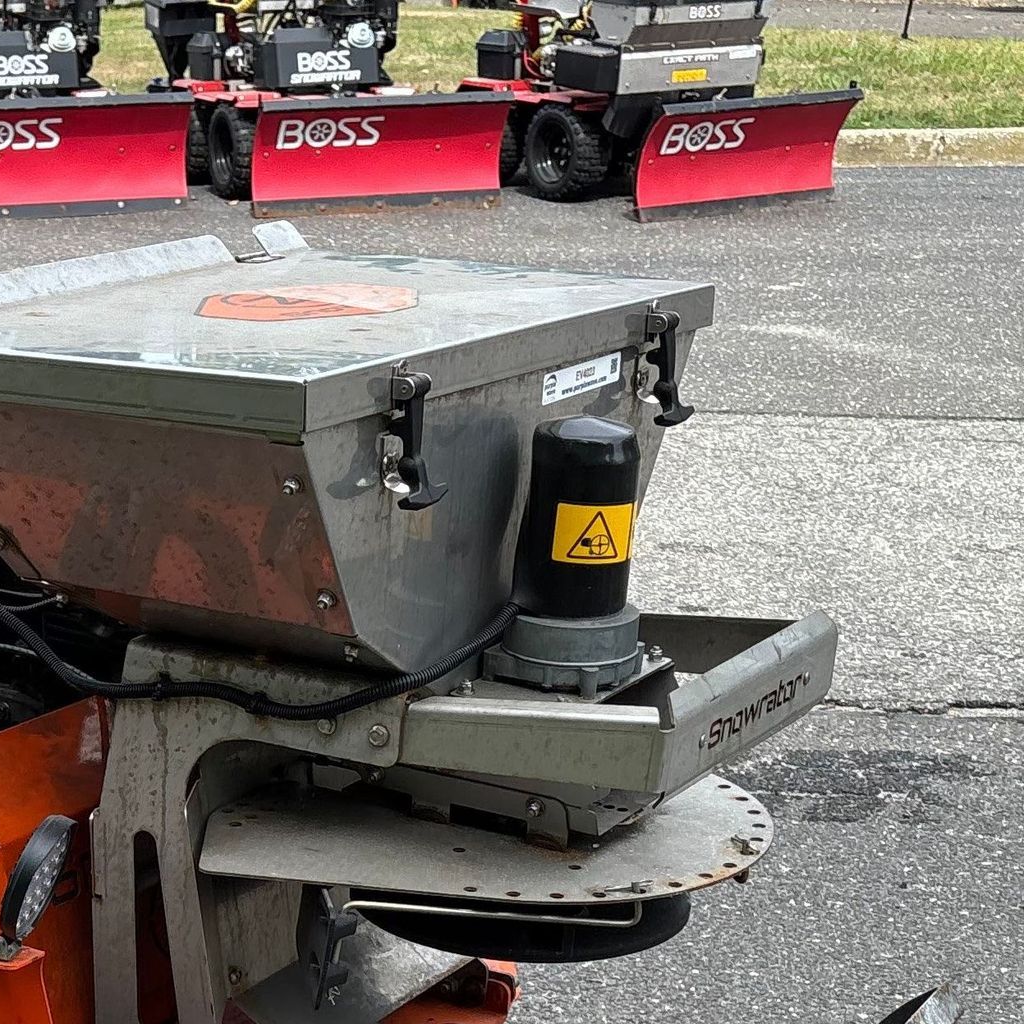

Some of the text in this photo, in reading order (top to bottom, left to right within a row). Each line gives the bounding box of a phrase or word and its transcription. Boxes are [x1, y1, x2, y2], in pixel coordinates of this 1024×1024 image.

[688, 4, 722, 19] BOSS
[296, 50, 351, 73] BOSS
[275, 115, 385, 151] BOSS
[659, 116, 756, 156] BOSS
[707, 673, 803, 749] Snowrator
